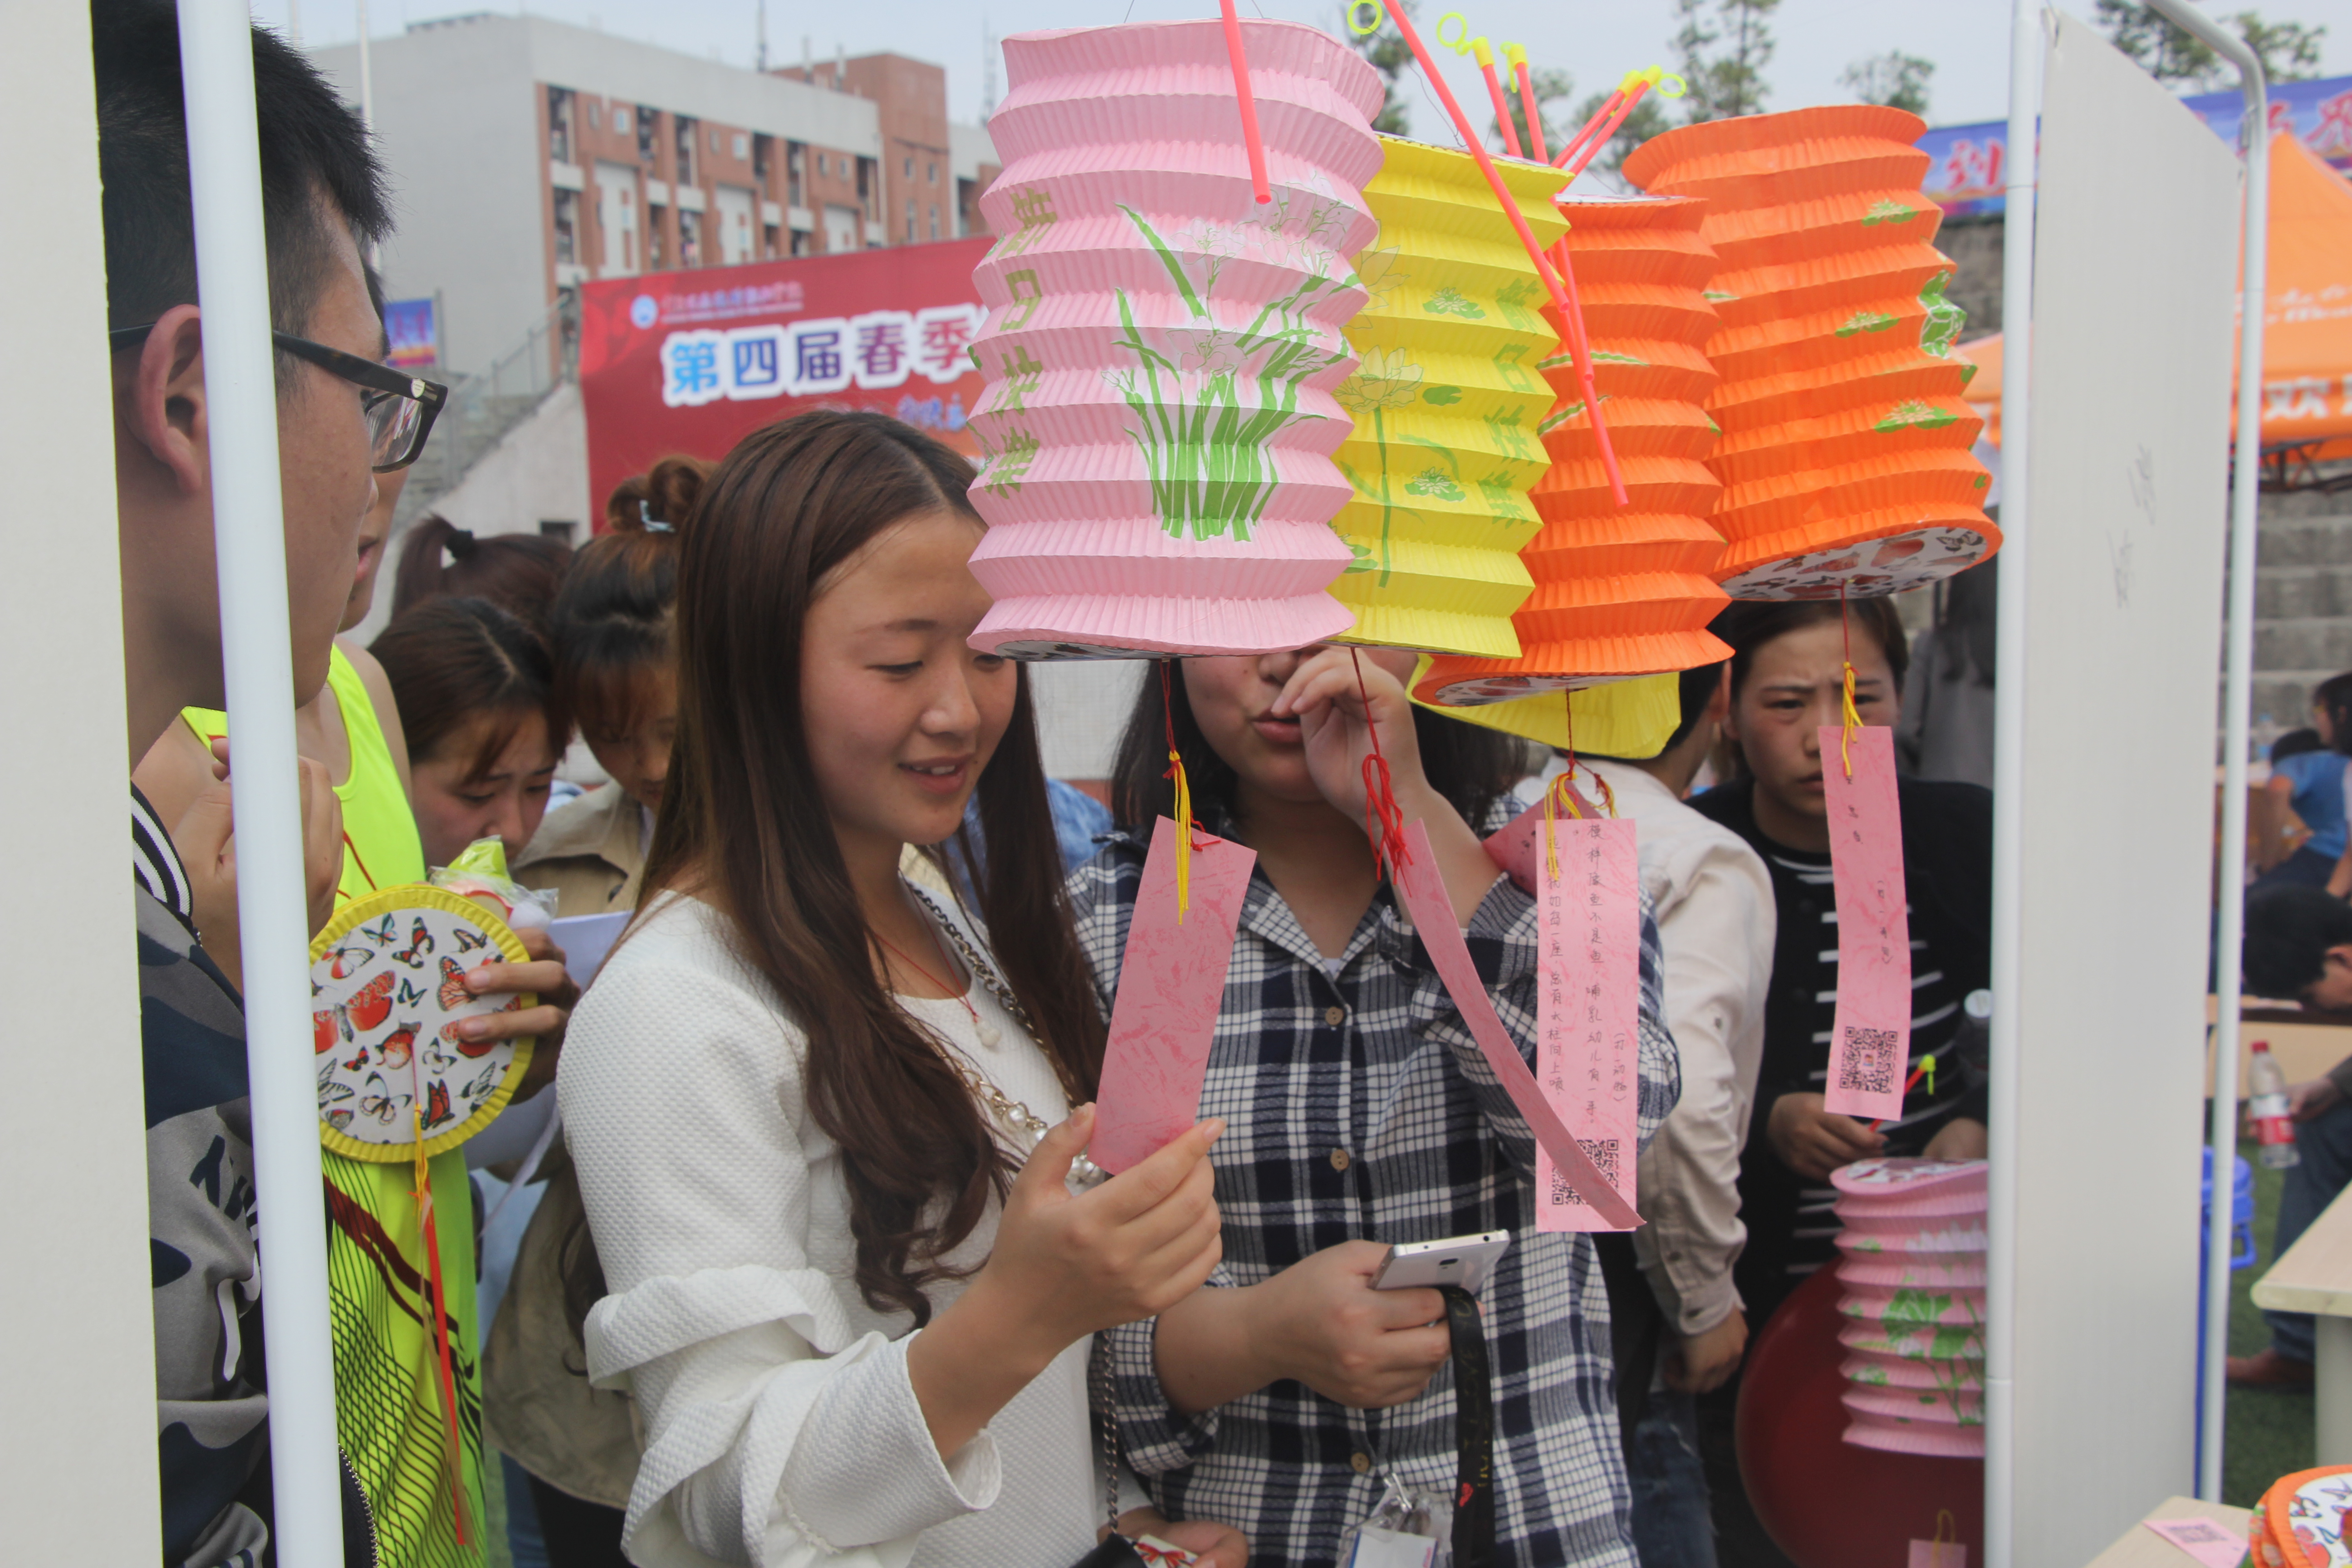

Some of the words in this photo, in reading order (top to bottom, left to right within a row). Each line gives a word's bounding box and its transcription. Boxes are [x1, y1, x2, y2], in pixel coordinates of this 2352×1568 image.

[666, 312, 974, 398] 第四届春季
